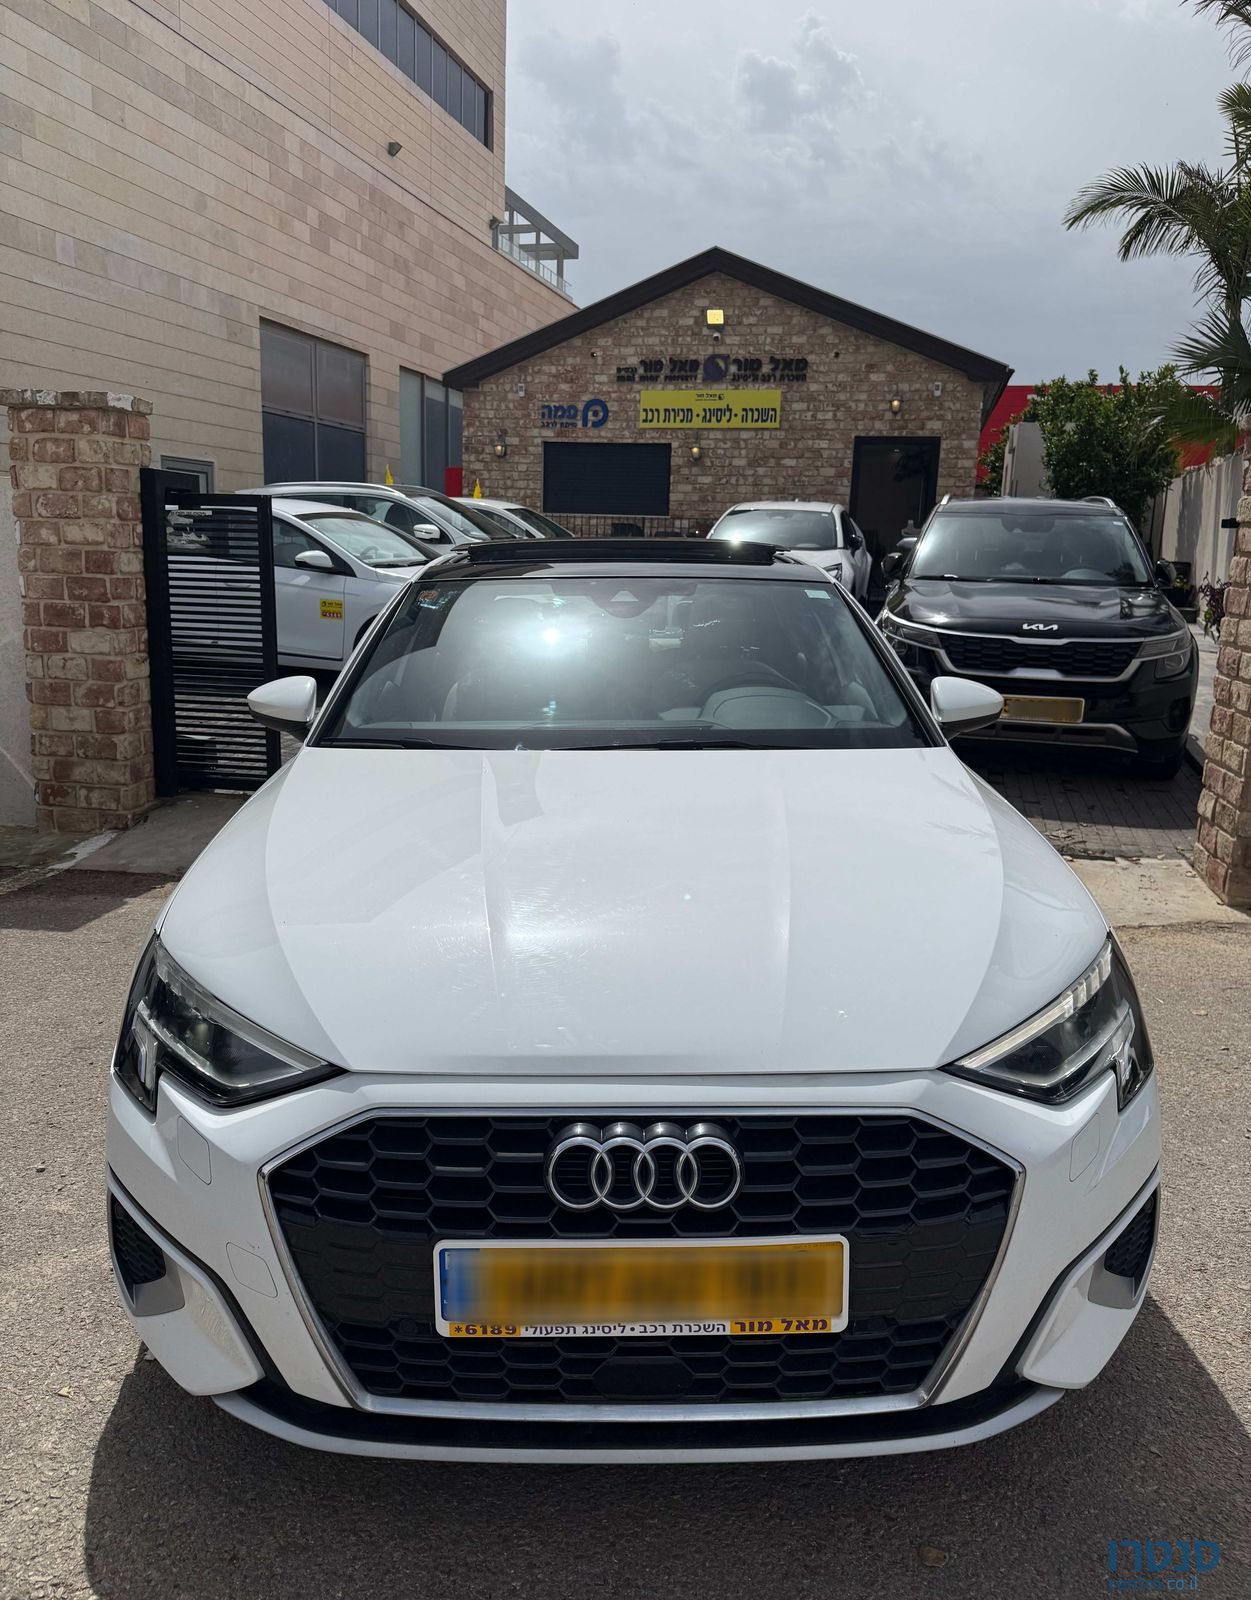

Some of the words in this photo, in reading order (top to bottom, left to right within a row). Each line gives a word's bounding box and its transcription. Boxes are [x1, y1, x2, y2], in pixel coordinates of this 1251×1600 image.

[732, 358, 763, 372] מור
[769, 356, 809, 372] מאל
[541, 404, 578, 419] פמה
[642, 407, 660, 423] רכב
[662, 407, 693, 423] מכירת
[702, 403, 733, 424] ליסינג
[741, 407, 777, 423] השכרה
[525, 1323, 577, 1336] תפעולי
[582, 1323, 626, 1336] ליסינג
[638, 1323, 667, 1334] רכב
[671, 1323, 726, 1334] השכרת
[734, 1320, 774, 1333] מור
[780, 1318, 828, 1332] מאל
